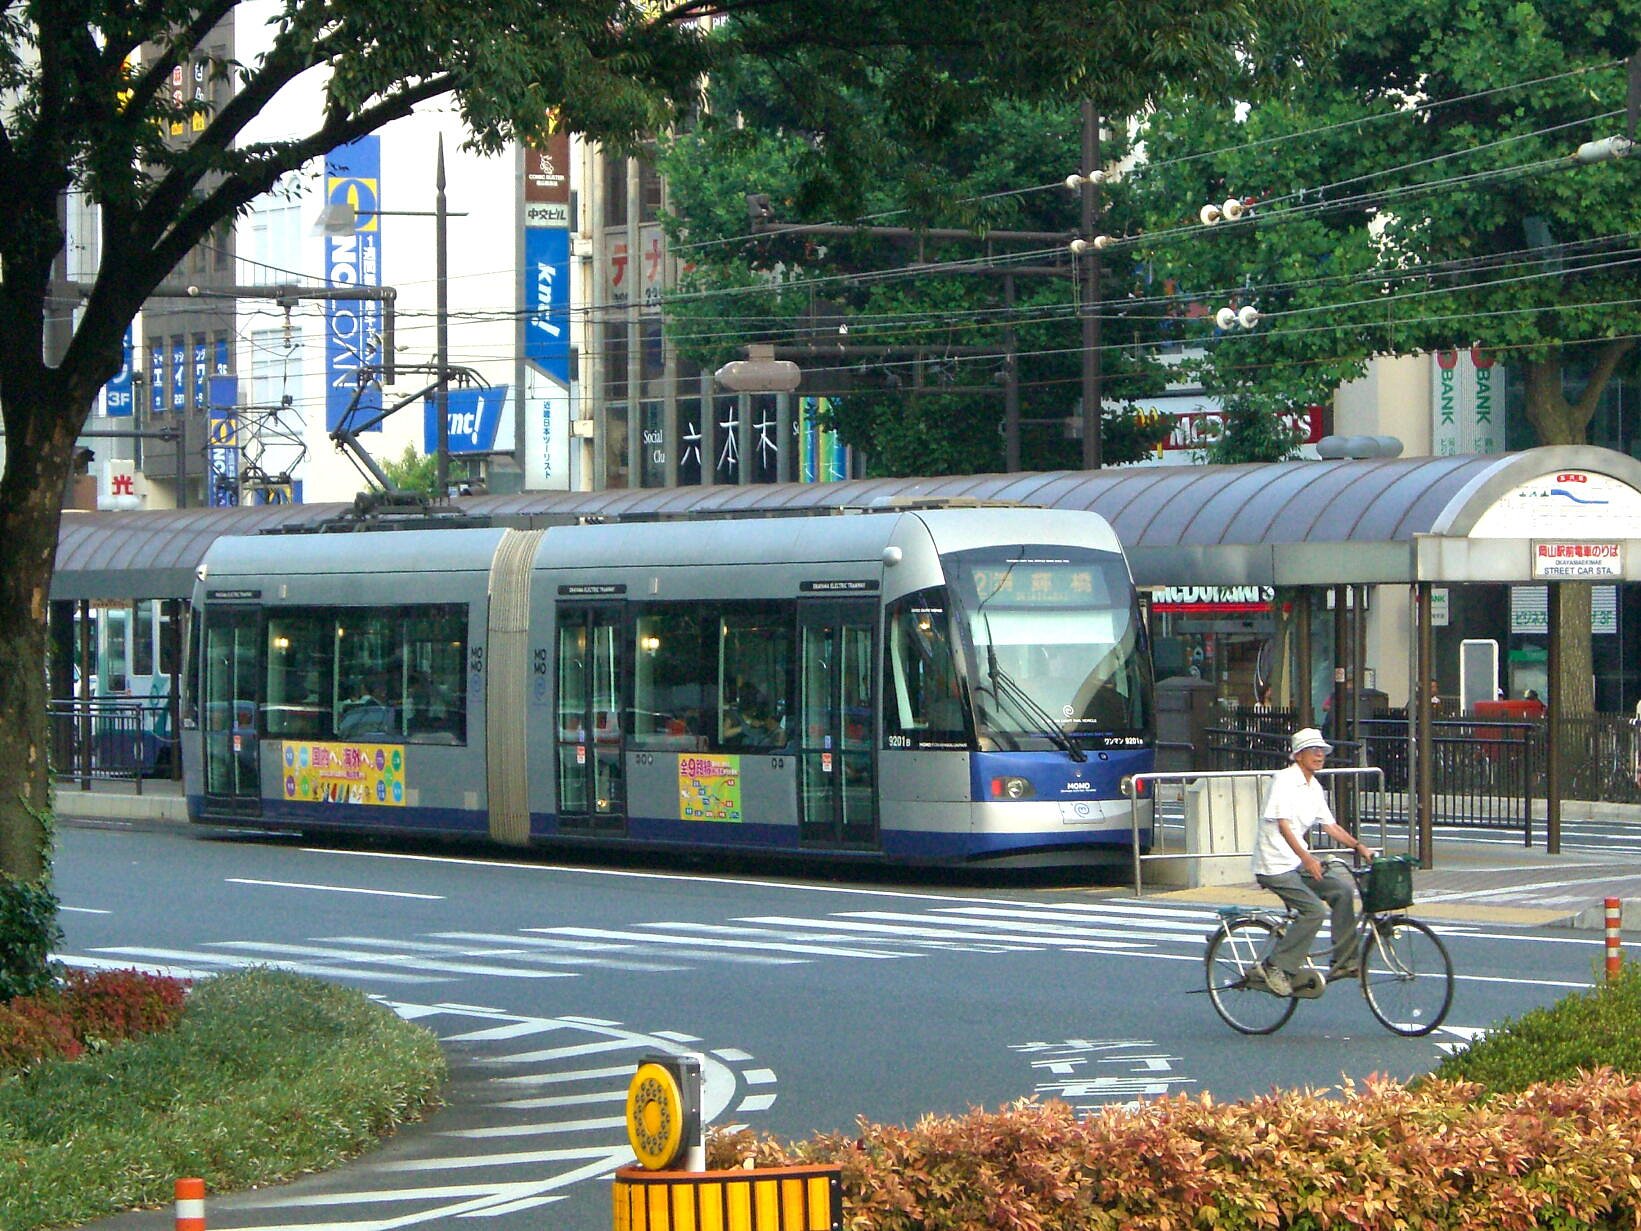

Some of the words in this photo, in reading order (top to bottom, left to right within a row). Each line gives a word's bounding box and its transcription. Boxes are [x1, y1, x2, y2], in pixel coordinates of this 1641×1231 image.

[108, 392, 130, 406] 3F
[1441, 369, 1454, 426] BANK
[1476, 368, 1492, 425] BANK
[643, 430, 663, 444] Social
[653, 450, 666, 463] Clu
[1538, 544, 1618, 557] 岡山駅前電車のりば
[1104, 738, 1124, 746] ワンマン
[1067, 782, 1091, 790] MOMO
